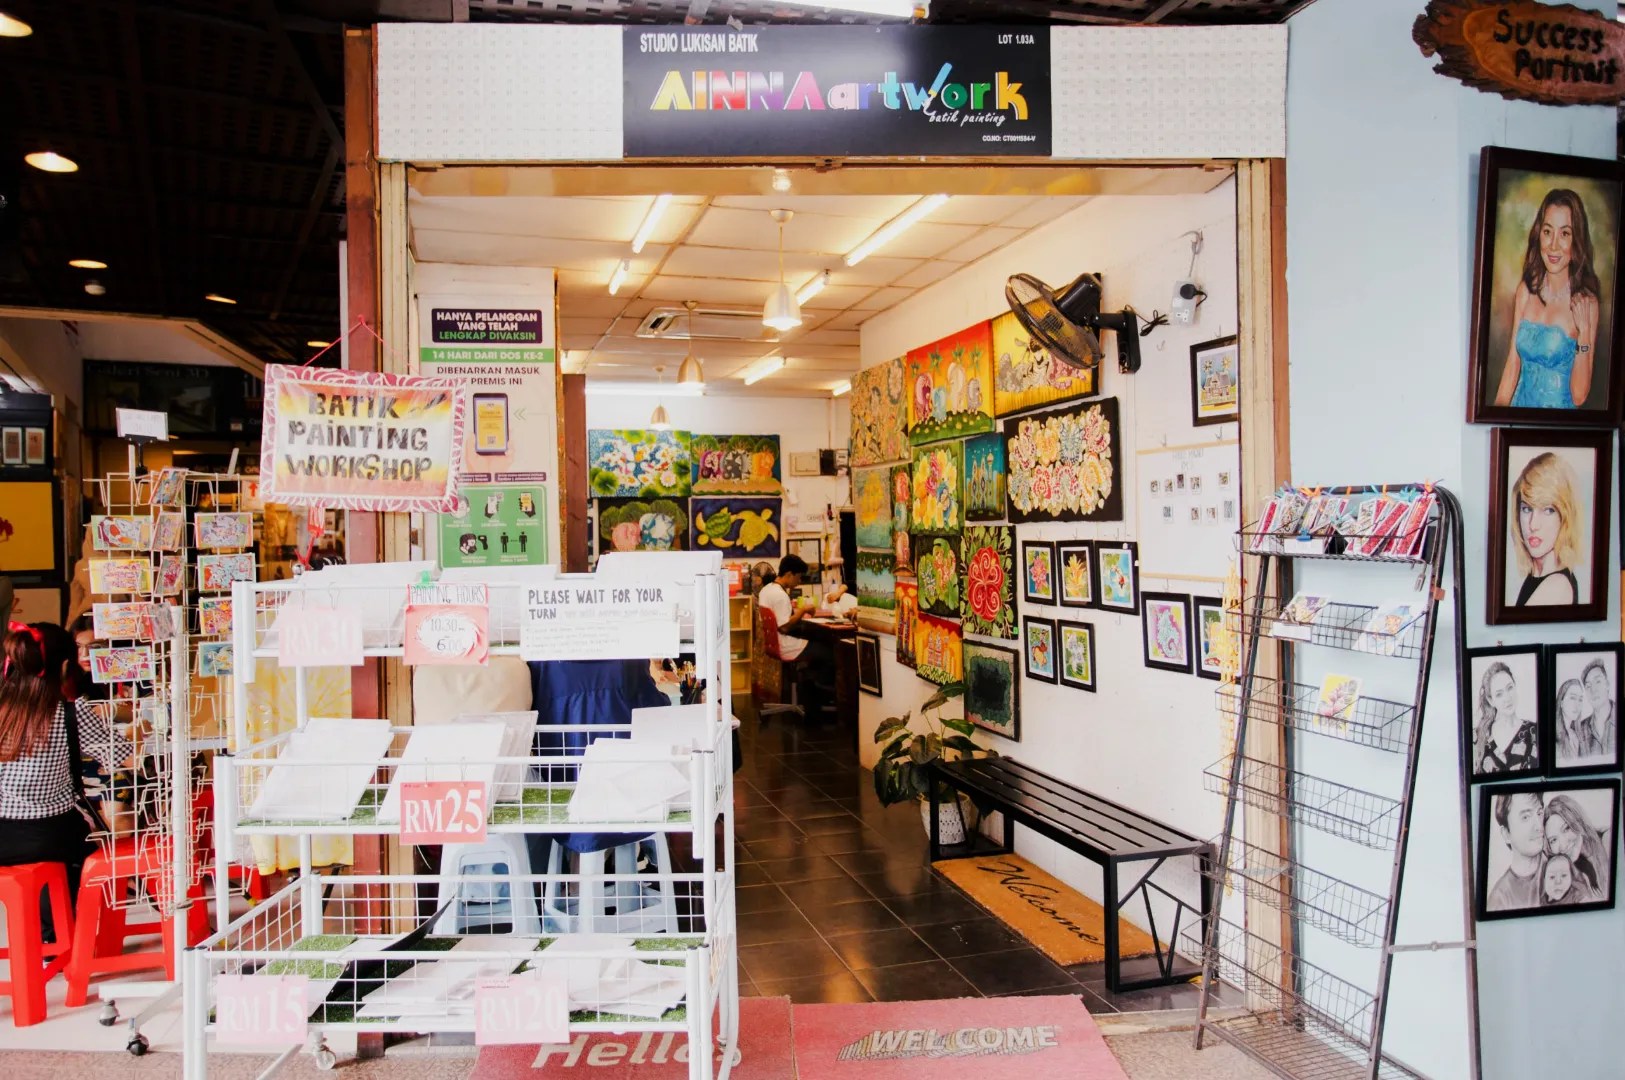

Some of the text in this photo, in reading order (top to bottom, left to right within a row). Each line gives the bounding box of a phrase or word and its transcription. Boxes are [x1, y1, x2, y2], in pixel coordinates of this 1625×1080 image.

[998, 34, 1035, 45] LOT 1.03A
[1494, 9, 1604, 53] Success
[640, 33, 758, 52] STUDIO LUKISAN BATIK
[1515, 49, 1618, 84] Portrait
[929, 110, 1006, 127] batik painting
[437, 312, 538, 322] HANYA PELANGGAN
[457, 322, 518, 331] YANG TELAH
[439, 331, 536, 340] LENGKAP DIVAKSIN
[433, 351, 544, 360] 14 HARI DARI DOS KE-2
[437, 366, 540, 375] DIBENARKAN MASUK
[470, 377, 523, 386] PREMIS INI
[308, 393, 400, 419] BATIK
[285, 454, 433, 482] WORKSHOP
[457, 586, 485, 603] HOURS
[528, 588, 663, 605] PLEASE WAIT FOR YOUR
[529, 608, 557, 620] TURN
[404, 788, 482, 833] RM25
[977, 861, 1104, 946] Welcome
[224, 986, 303, 1033] RM15
[481, 986, 561, 1033] RM20
[858, 1025, 1060, 1057] WELCOME
